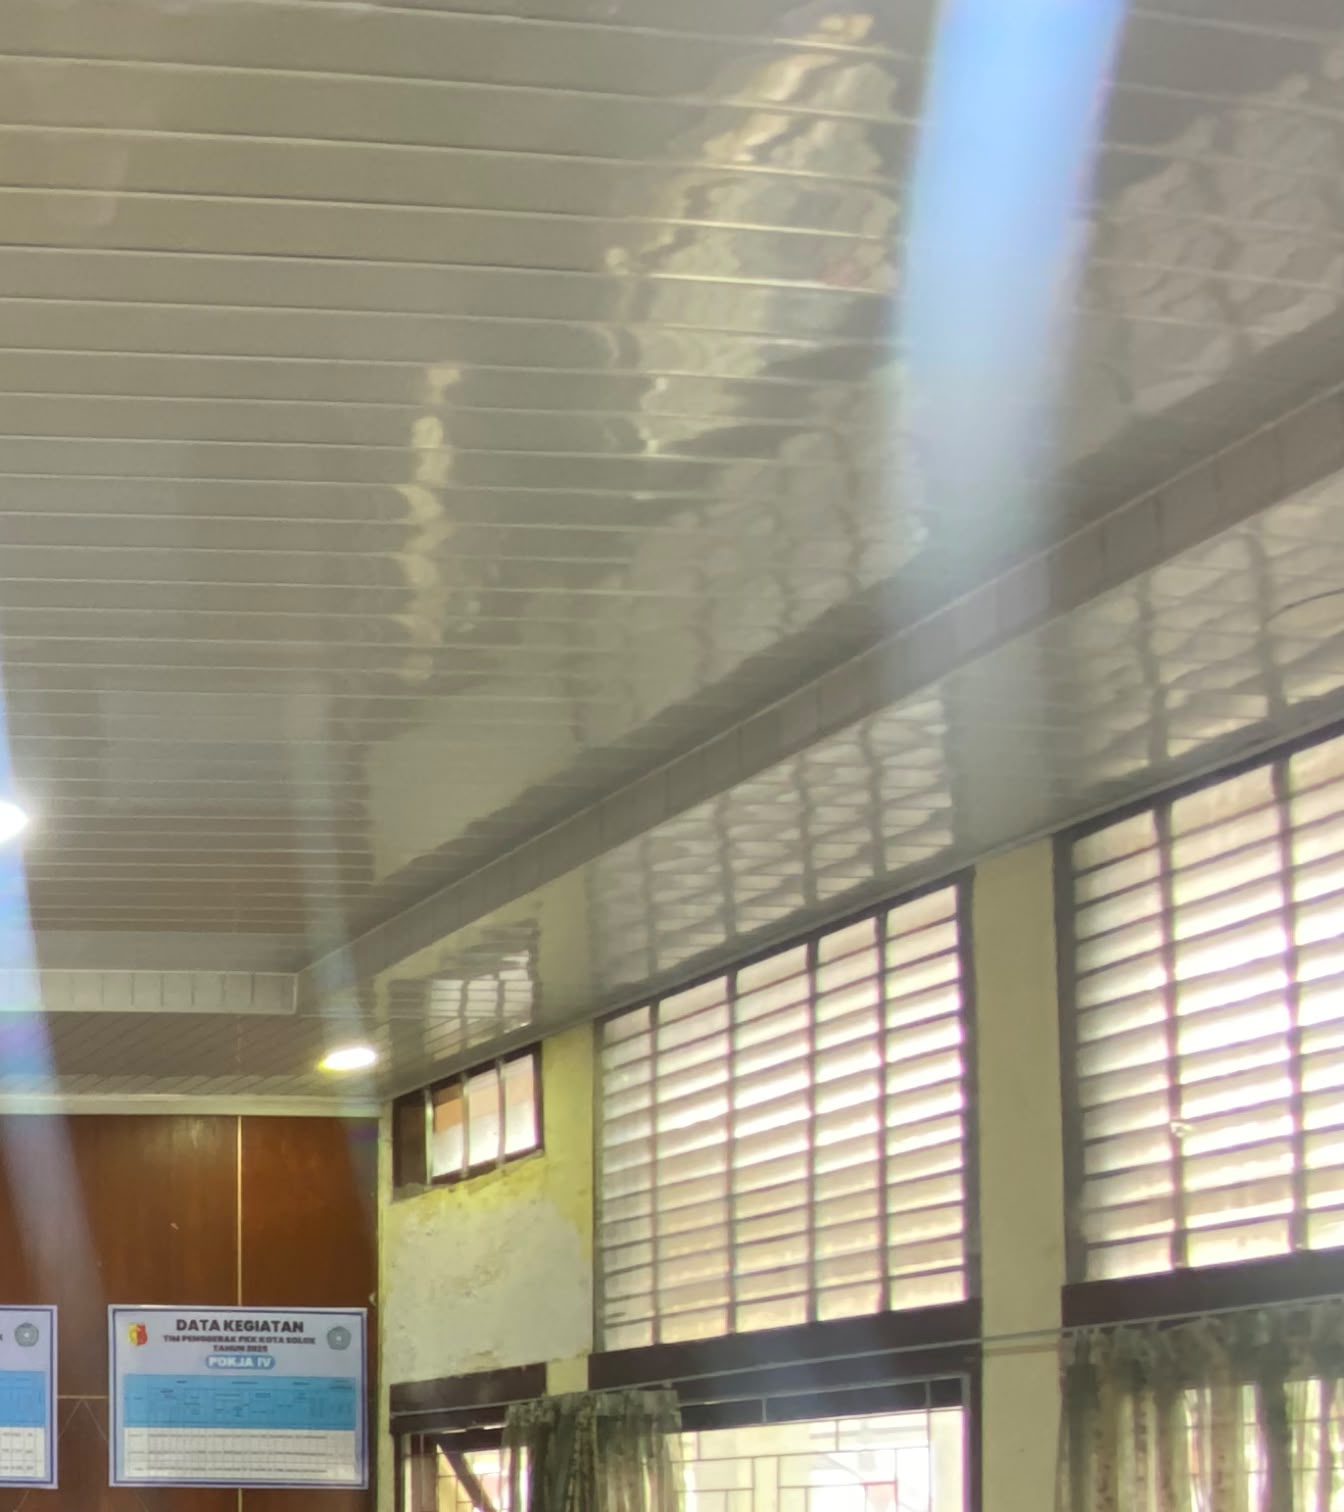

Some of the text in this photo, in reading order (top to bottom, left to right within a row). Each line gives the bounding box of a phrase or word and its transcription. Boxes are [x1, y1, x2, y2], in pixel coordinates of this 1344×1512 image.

[176, 1320, 304, 1333] DATA KEGIATAN
[260, 1336, 283, 1344] KOTA
[209, 1357, 271, 1367] POKJA IV
